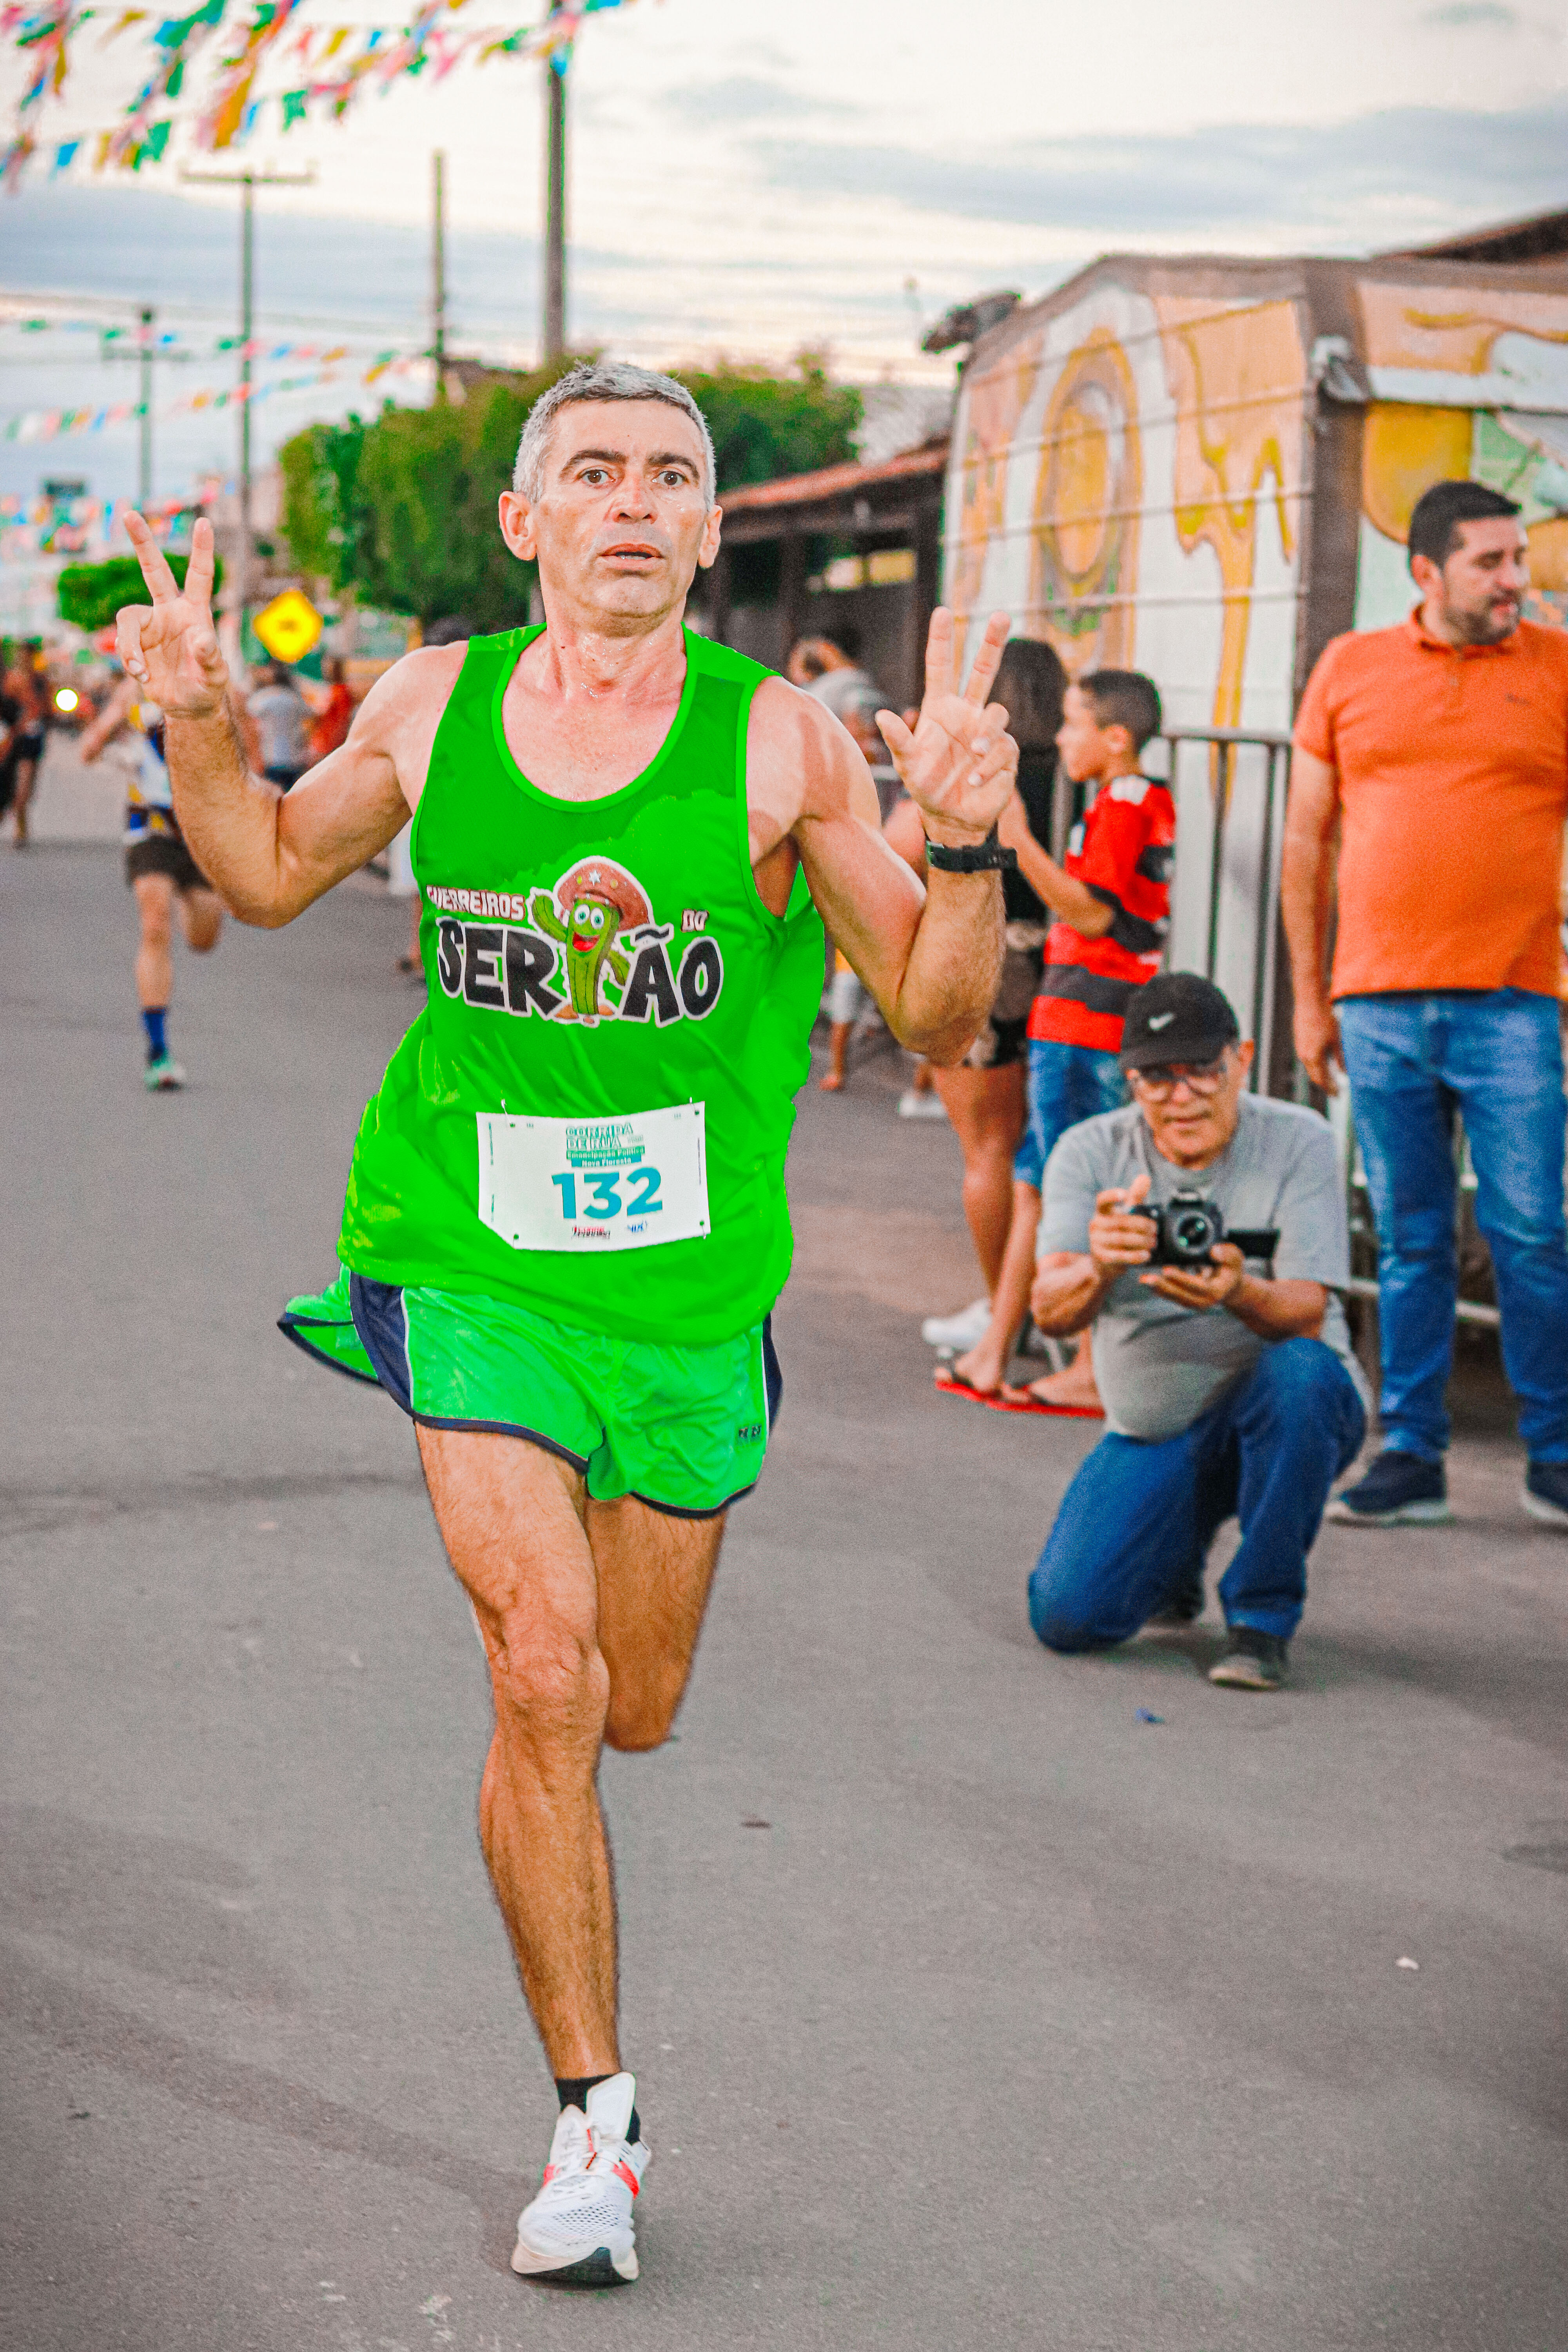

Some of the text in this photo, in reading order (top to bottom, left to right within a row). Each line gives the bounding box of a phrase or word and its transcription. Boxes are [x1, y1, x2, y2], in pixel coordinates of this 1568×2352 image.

[426, 884, 710, 932] GUERREIROS DO
[566, 1123, 633, 1137] CORRIDA
[567, 1137, 587, 1150] DE
[590, 1136, 621, 1149] RUA
[552, 1167, 662, 1219] 132
